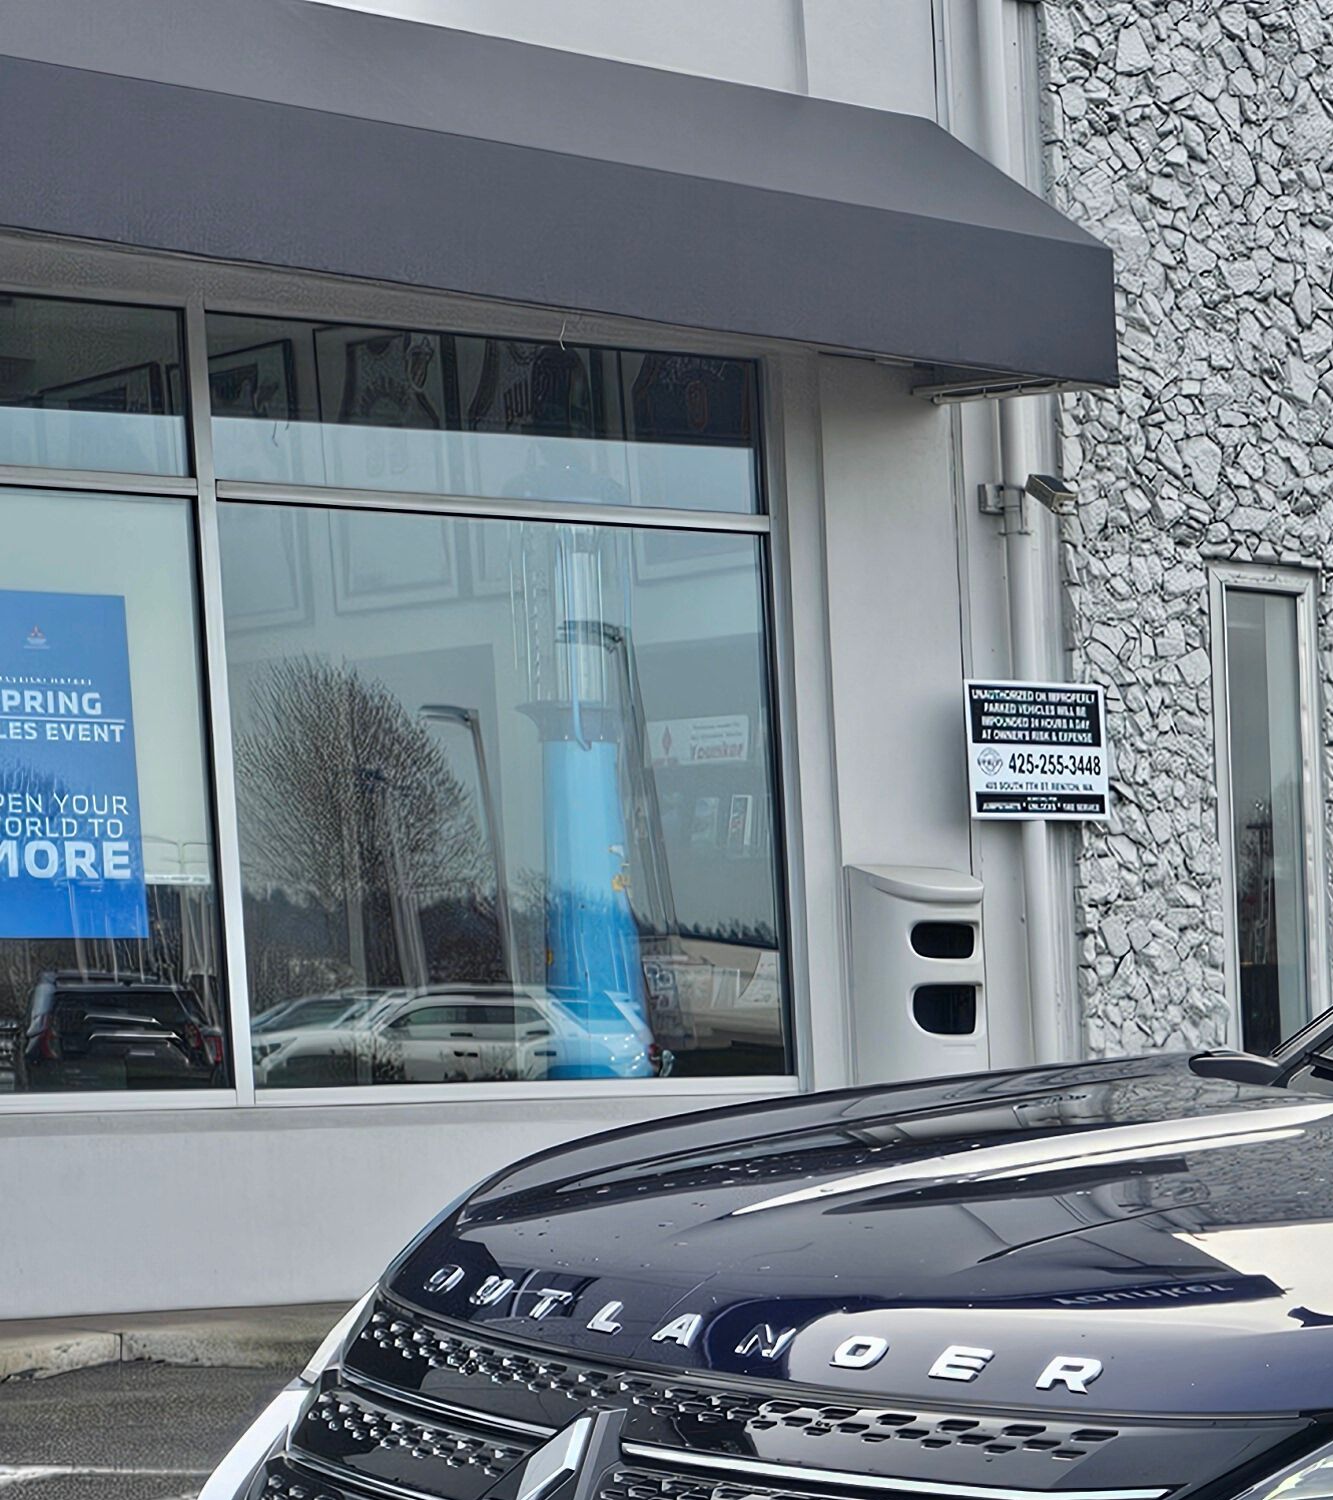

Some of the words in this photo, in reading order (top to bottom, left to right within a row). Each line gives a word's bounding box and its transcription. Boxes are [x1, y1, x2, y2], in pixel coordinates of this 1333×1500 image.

[46, 722, 125, 743] EVENT
[1008, 753, 1101, 776] 425-255-3448
[53, 791, 129, 815] YOUR
[88, 818, 123, 838] TO
[422, 1263, 1105, 1394] OUTLANDER
